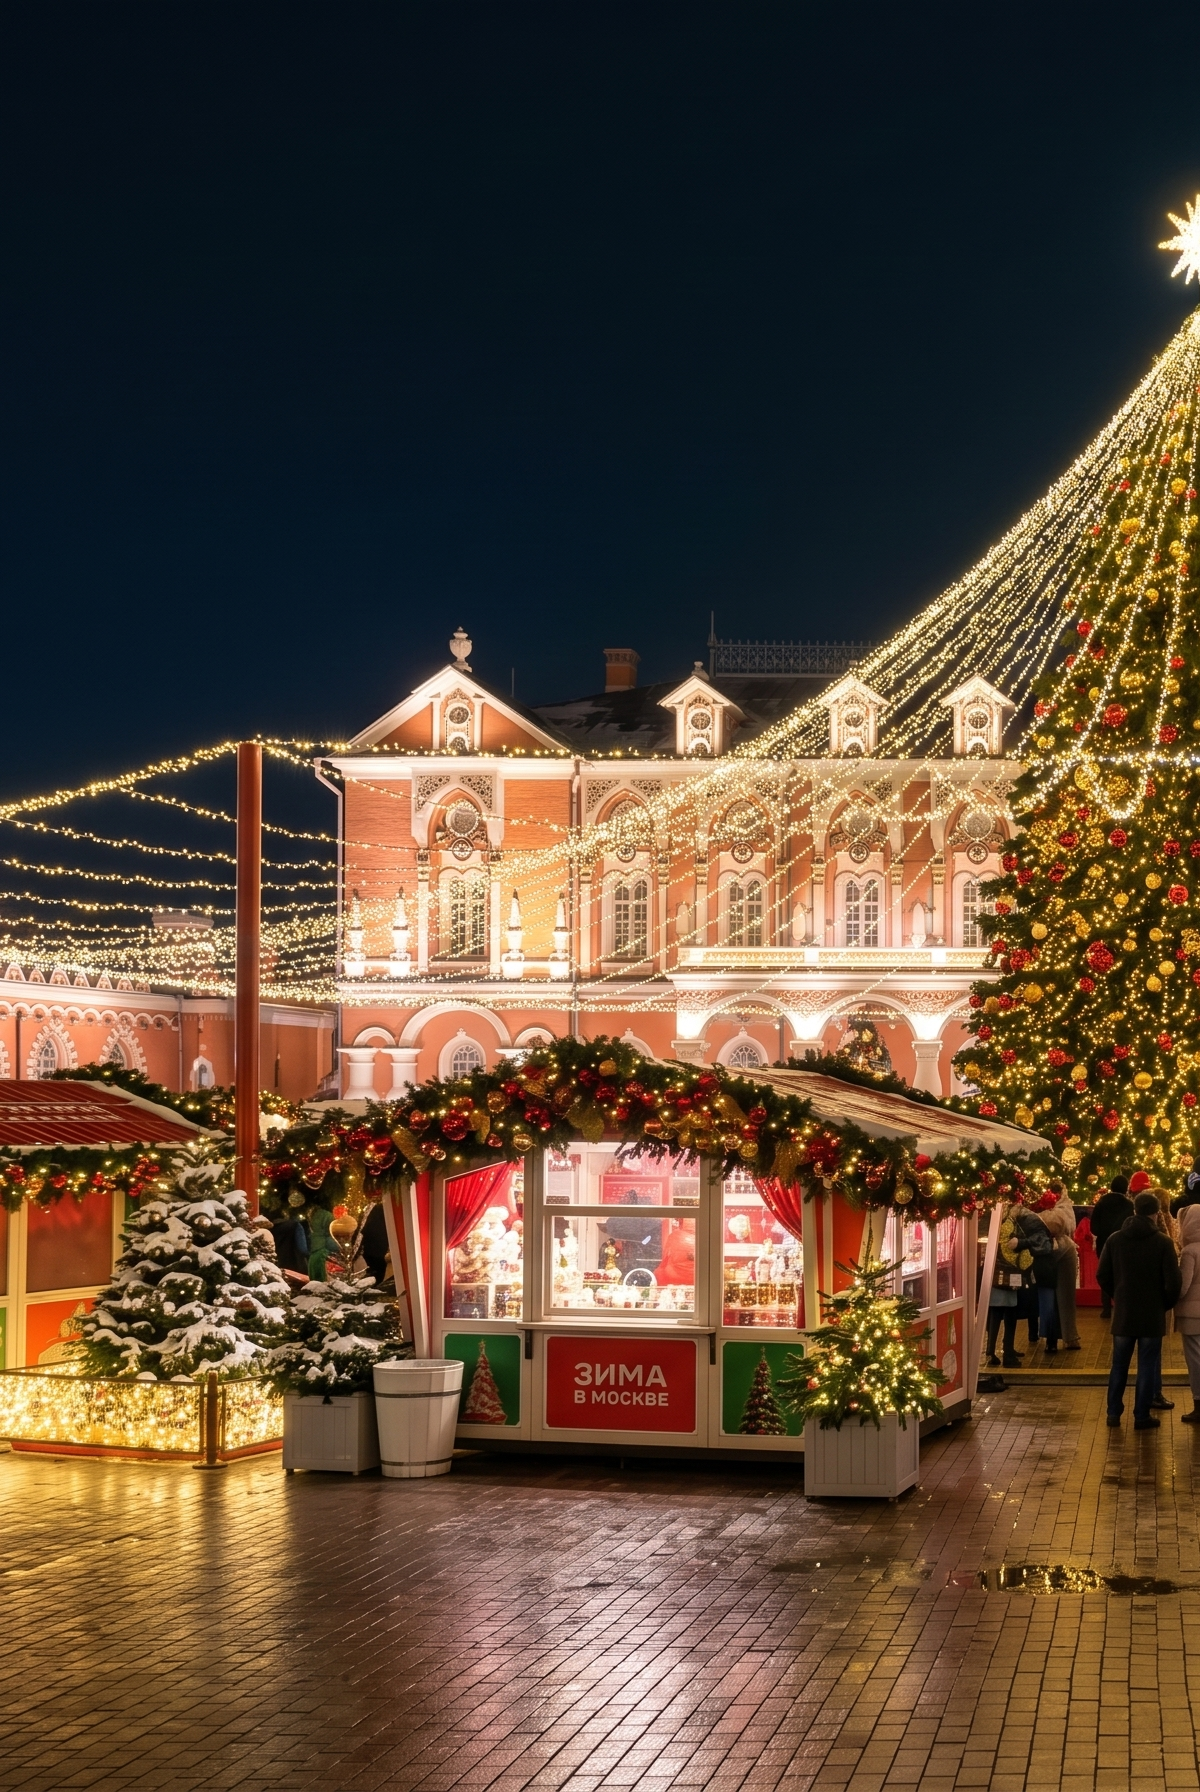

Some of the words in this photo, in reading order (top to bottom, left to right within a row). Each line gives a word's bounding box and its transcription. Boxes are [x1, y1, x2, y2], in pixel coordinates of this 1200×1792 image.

[574, 1362, 668, 1388] ЗИМА
[574, 1389, 587, 1405] В
[591, 1390, 669, 1407] МОСКВЕ
